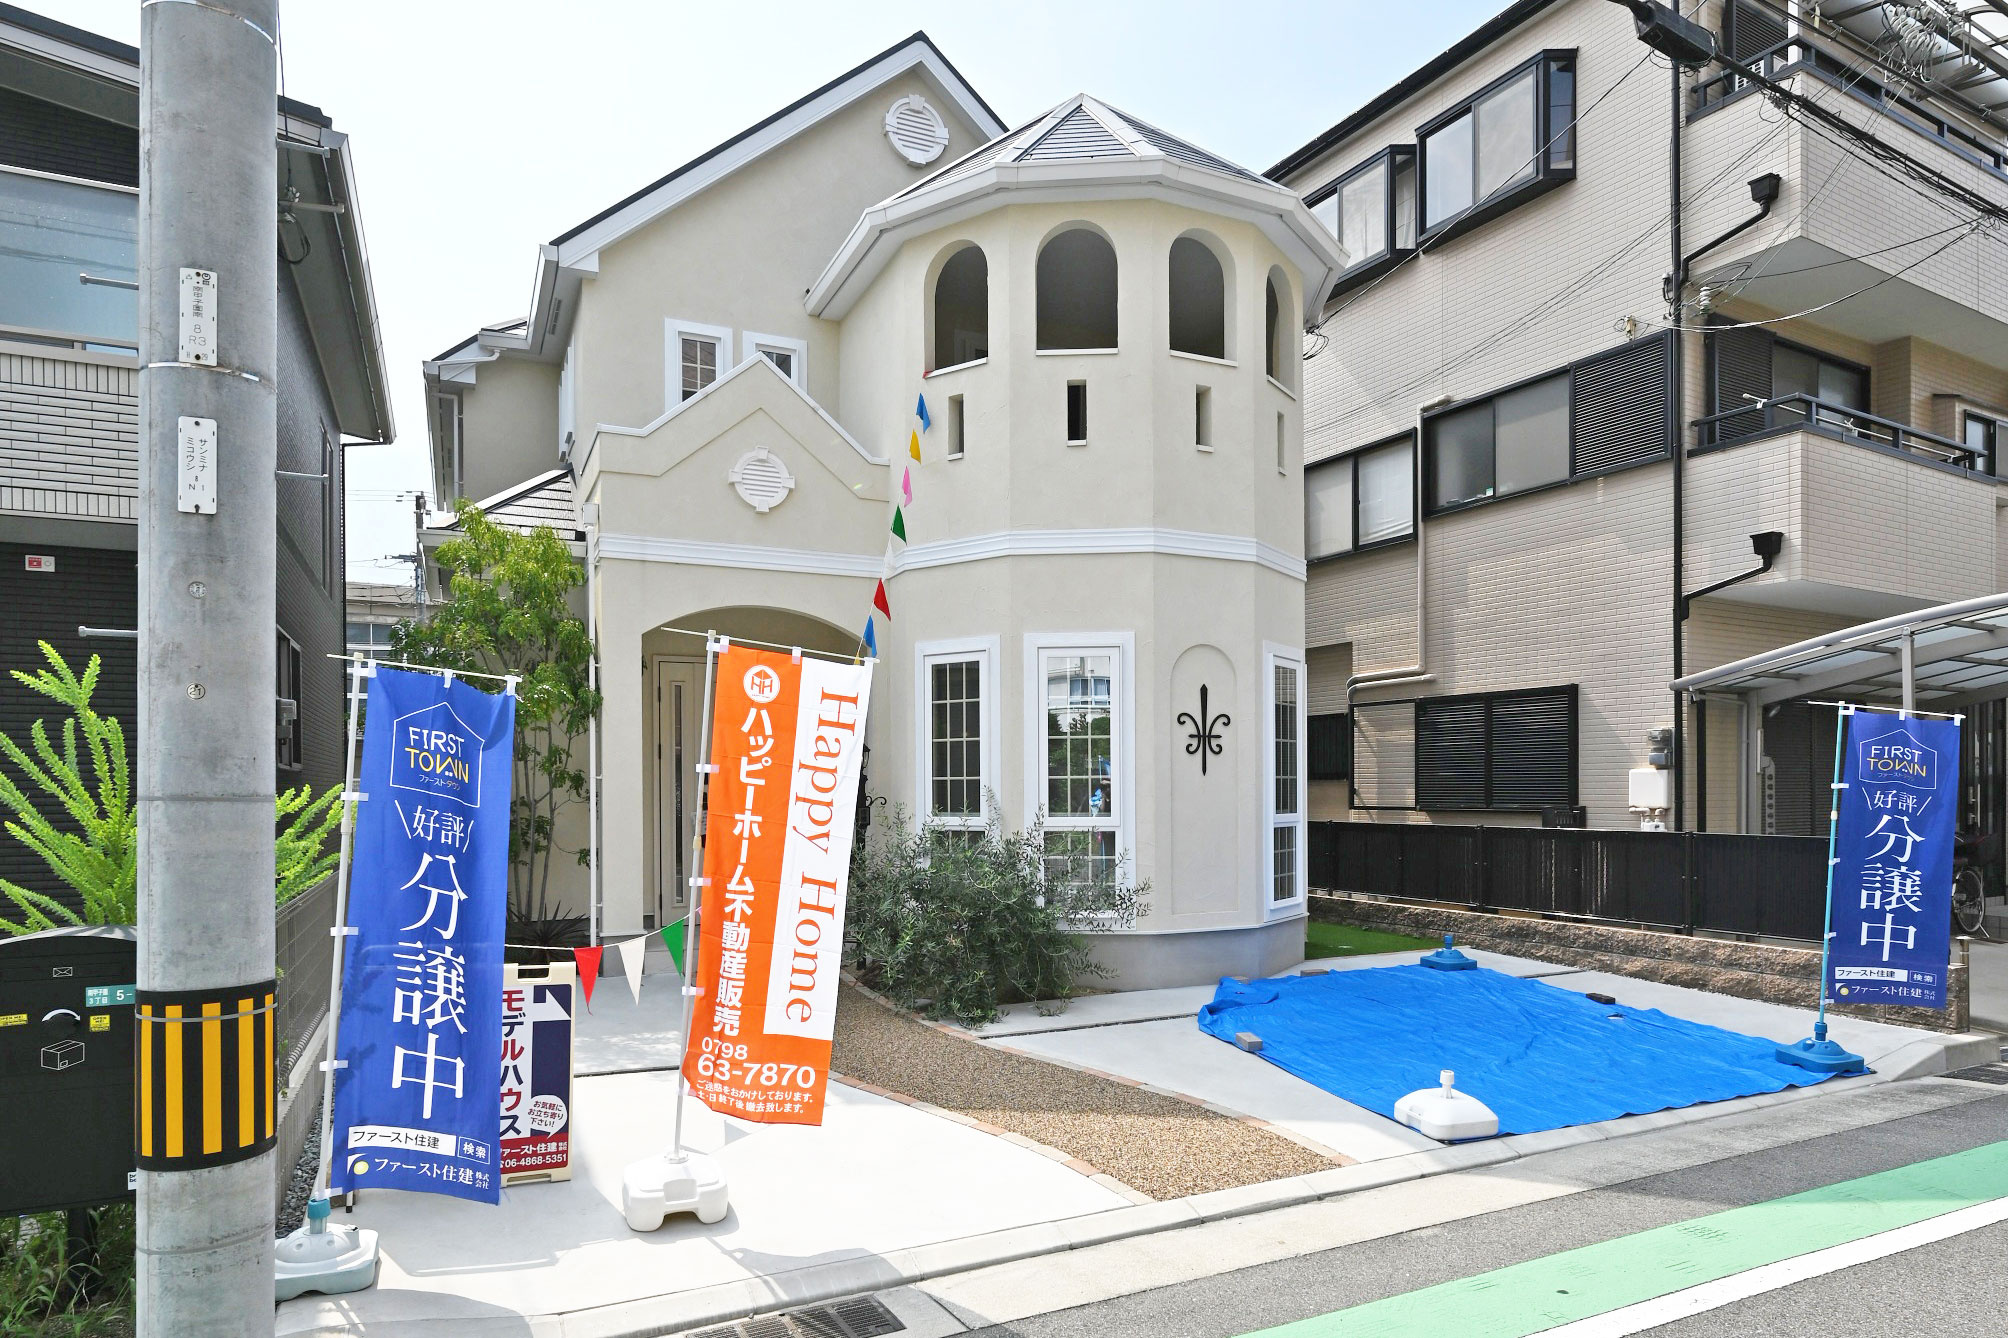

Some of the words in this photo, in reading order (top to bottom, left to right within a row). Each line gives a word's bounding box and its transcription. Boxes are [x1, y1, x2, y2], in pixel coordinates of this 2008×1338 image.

[188, 335, 206, 346] R3
[194, 324, 202, 334] 8
[189, 686, 202, 696] 21
[409, 726, 464, 757] FIRST
[405, 747, 468, 784] TOWN
[1872, 746, 1922, 762] FIRST
[793, 686, 859, 854] Happy
[1866, 758, 1926, 776] TOWN
[1874, 790, 1918, 813] 好評
[413, 805, 464, 848] 好評
[714, 708, 774, 1037] ハッピーホーム不動産販売
[1860, 814, 1926, 962] 分譲中
[786, 872, 838, 1023] Home
[392, 852, 468, 1119] 分譲中
[1838, 970, 1896, 978] ファースト住建
[1913, 974, 1933, 982] 検索
[1852, 986, 1922, 998] ファースト住建
[702, 1037, 748, 1060] 0798
[500, 990, 526, 1138] モデルハウス
[698, 1054, 816, 1088] 63-7870
[528, 1108, 564, 1120] お立ち寄り
[534, 1101, 562, 1112] お気軽に
[354, 1131, 440, 1149] ファースト住建
[463, 1142, 486, 1158] 検索
[500, 1142, 558, 1156] ァースト住建
[374, 1158, 474, 1184] ファースト住建
[505, 1154, 566, 1167] 06-4868-5351
